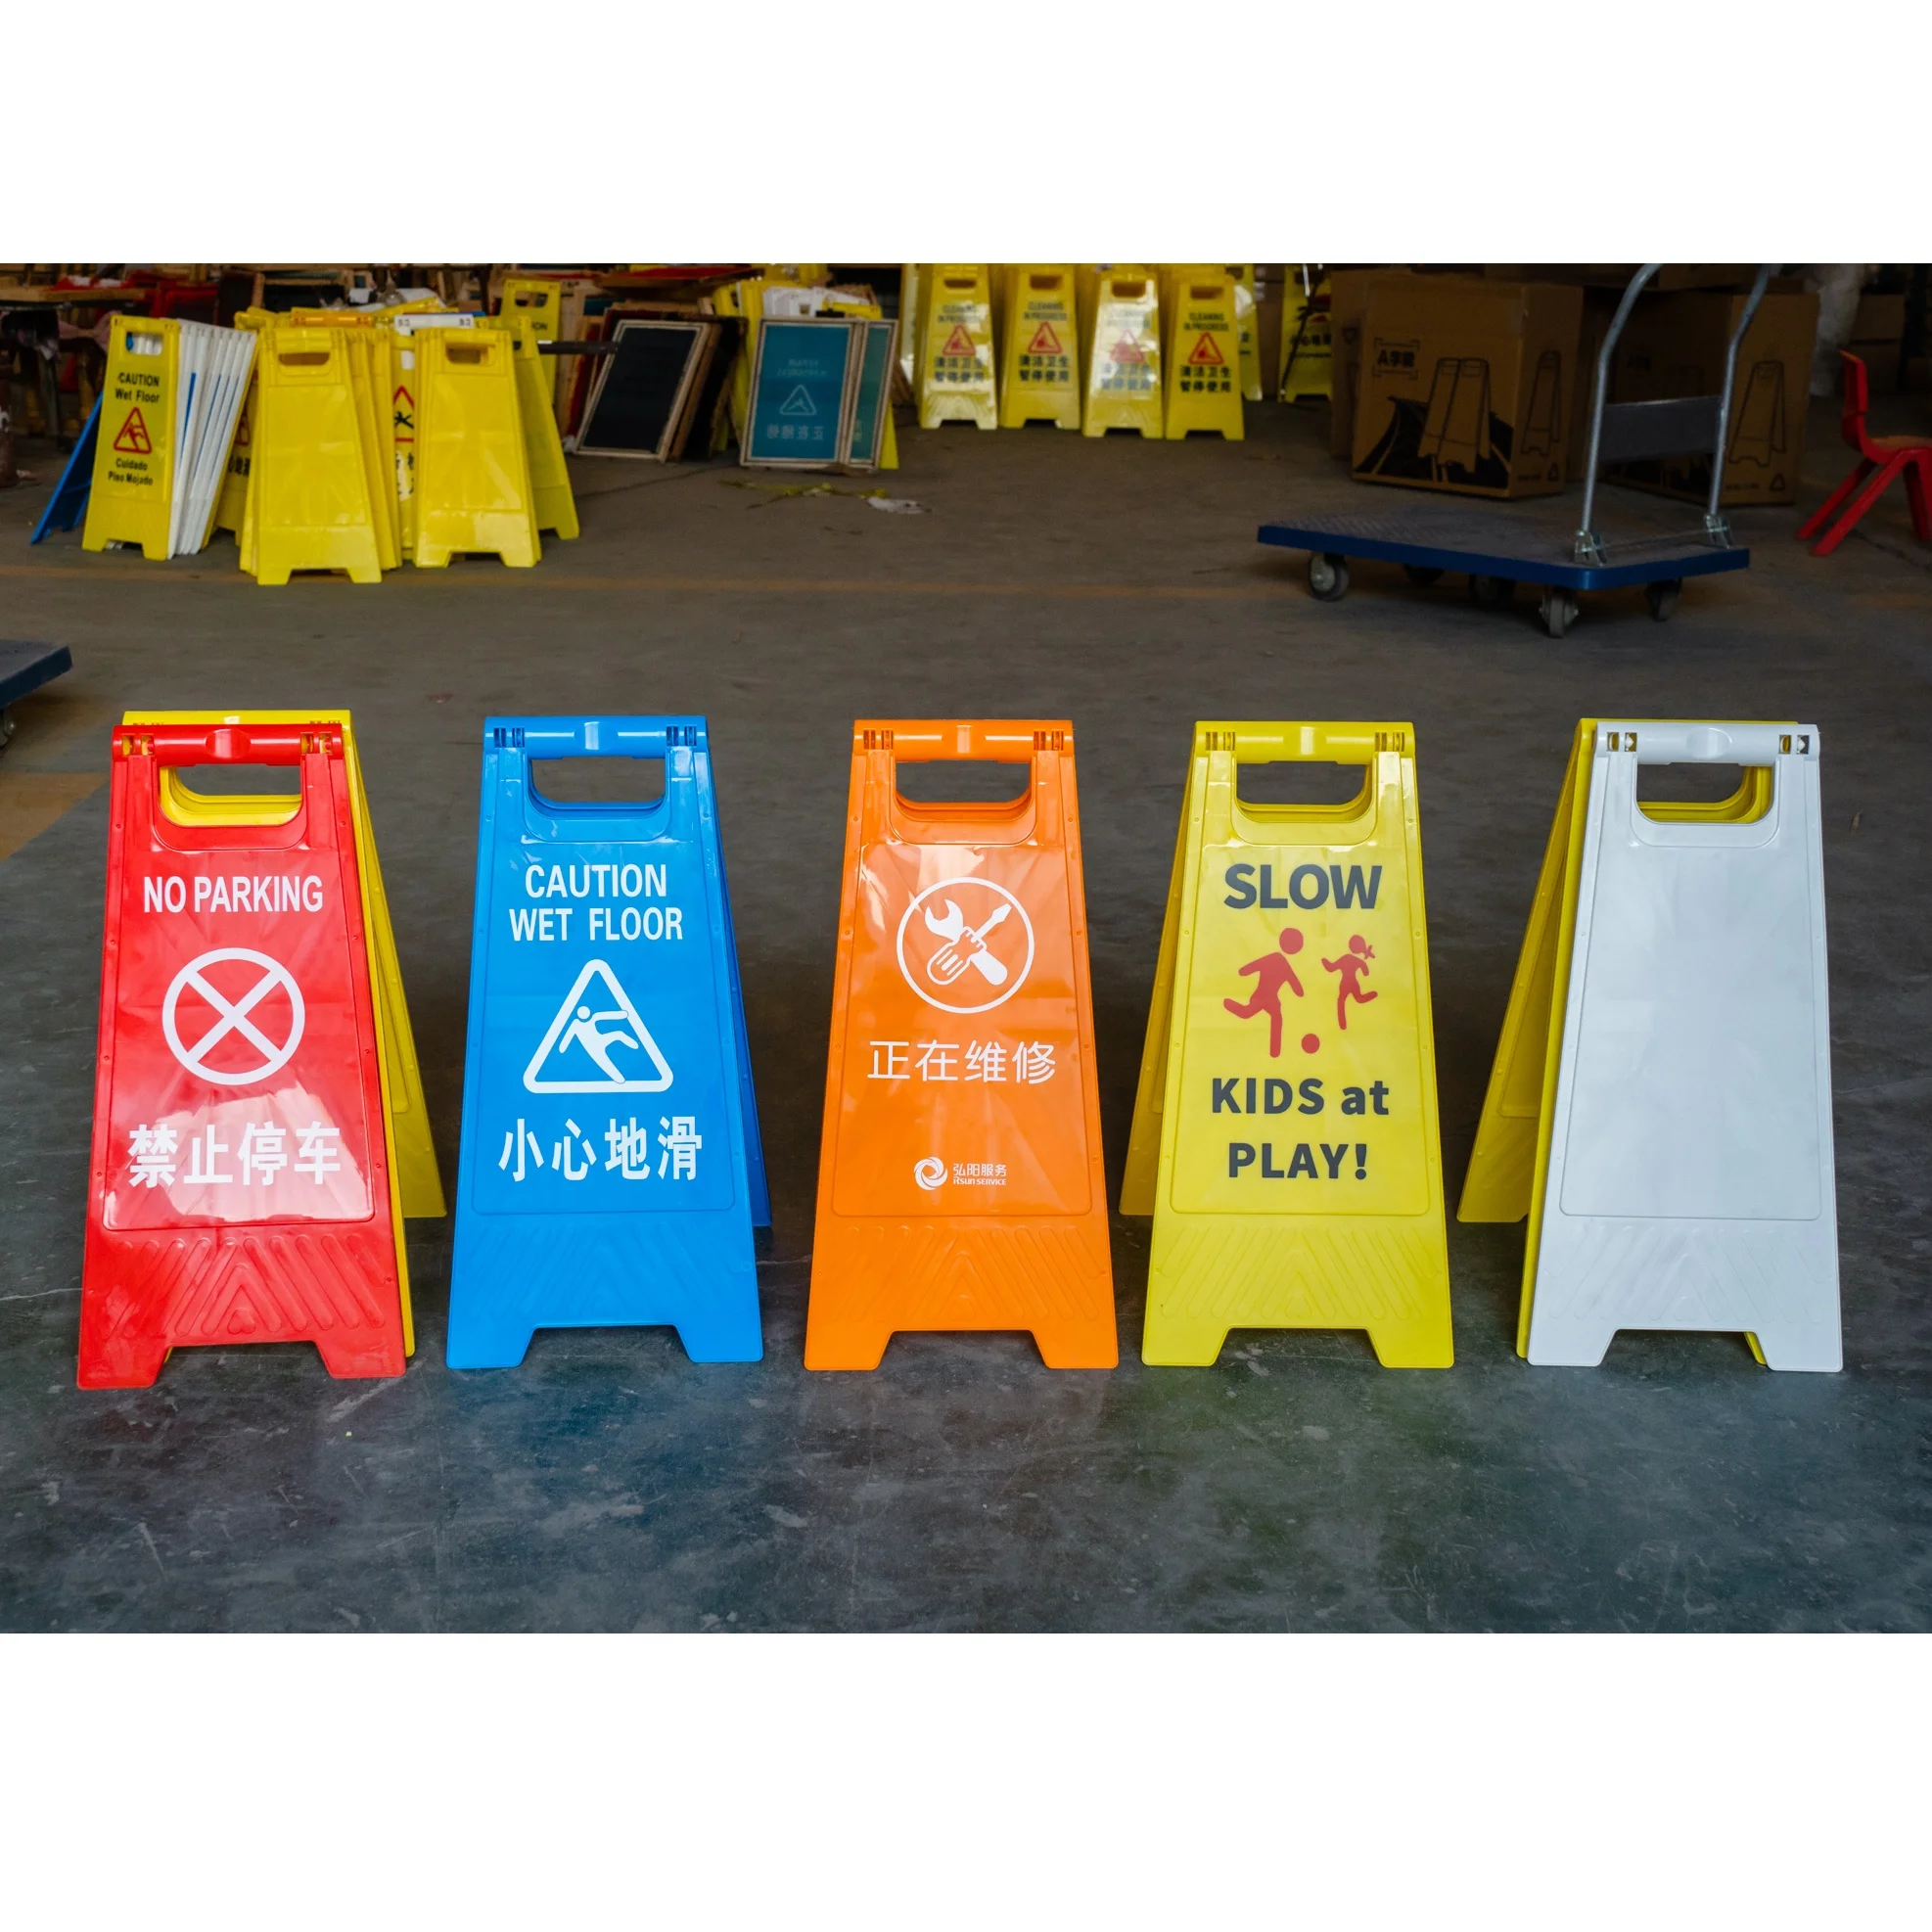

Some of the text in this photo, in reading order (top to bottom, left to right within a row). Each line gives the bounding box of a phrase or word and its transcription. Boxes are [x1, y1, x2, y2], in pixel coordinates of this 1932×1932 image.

[1188, 312, 1225, 322] CLEANING
[118, 372, 160, 387] CAUTION
[1180, 365, 1230, 377] 清洁卫生
[115, 388, 160, 403] Wet Floor
[108, 471, 154, 486] Piso Mojado
[115, 458, 148, 471] Cuidado
[144, 875, 324, 913] NO PARKING
[526, 864, 667, 897] CAUTION
[1224, 863, 1382, 910] SLOW
[510, 906, 683, 941] WET FLOOR
[867, 1039, 1056, 1083] 正在维修
[1213, 1078, 1390, 1115] KIDS at
[128, 1121, 341, 1188] 禁止停车
[498, 1116, 703, 1182] 小心地滑
[1229, 1142, 1367, 1180] PLAY!
[953, 1163, 1007, 1177] 弘阳服务
[976, 1177, 1007, 1186] SERVICE
